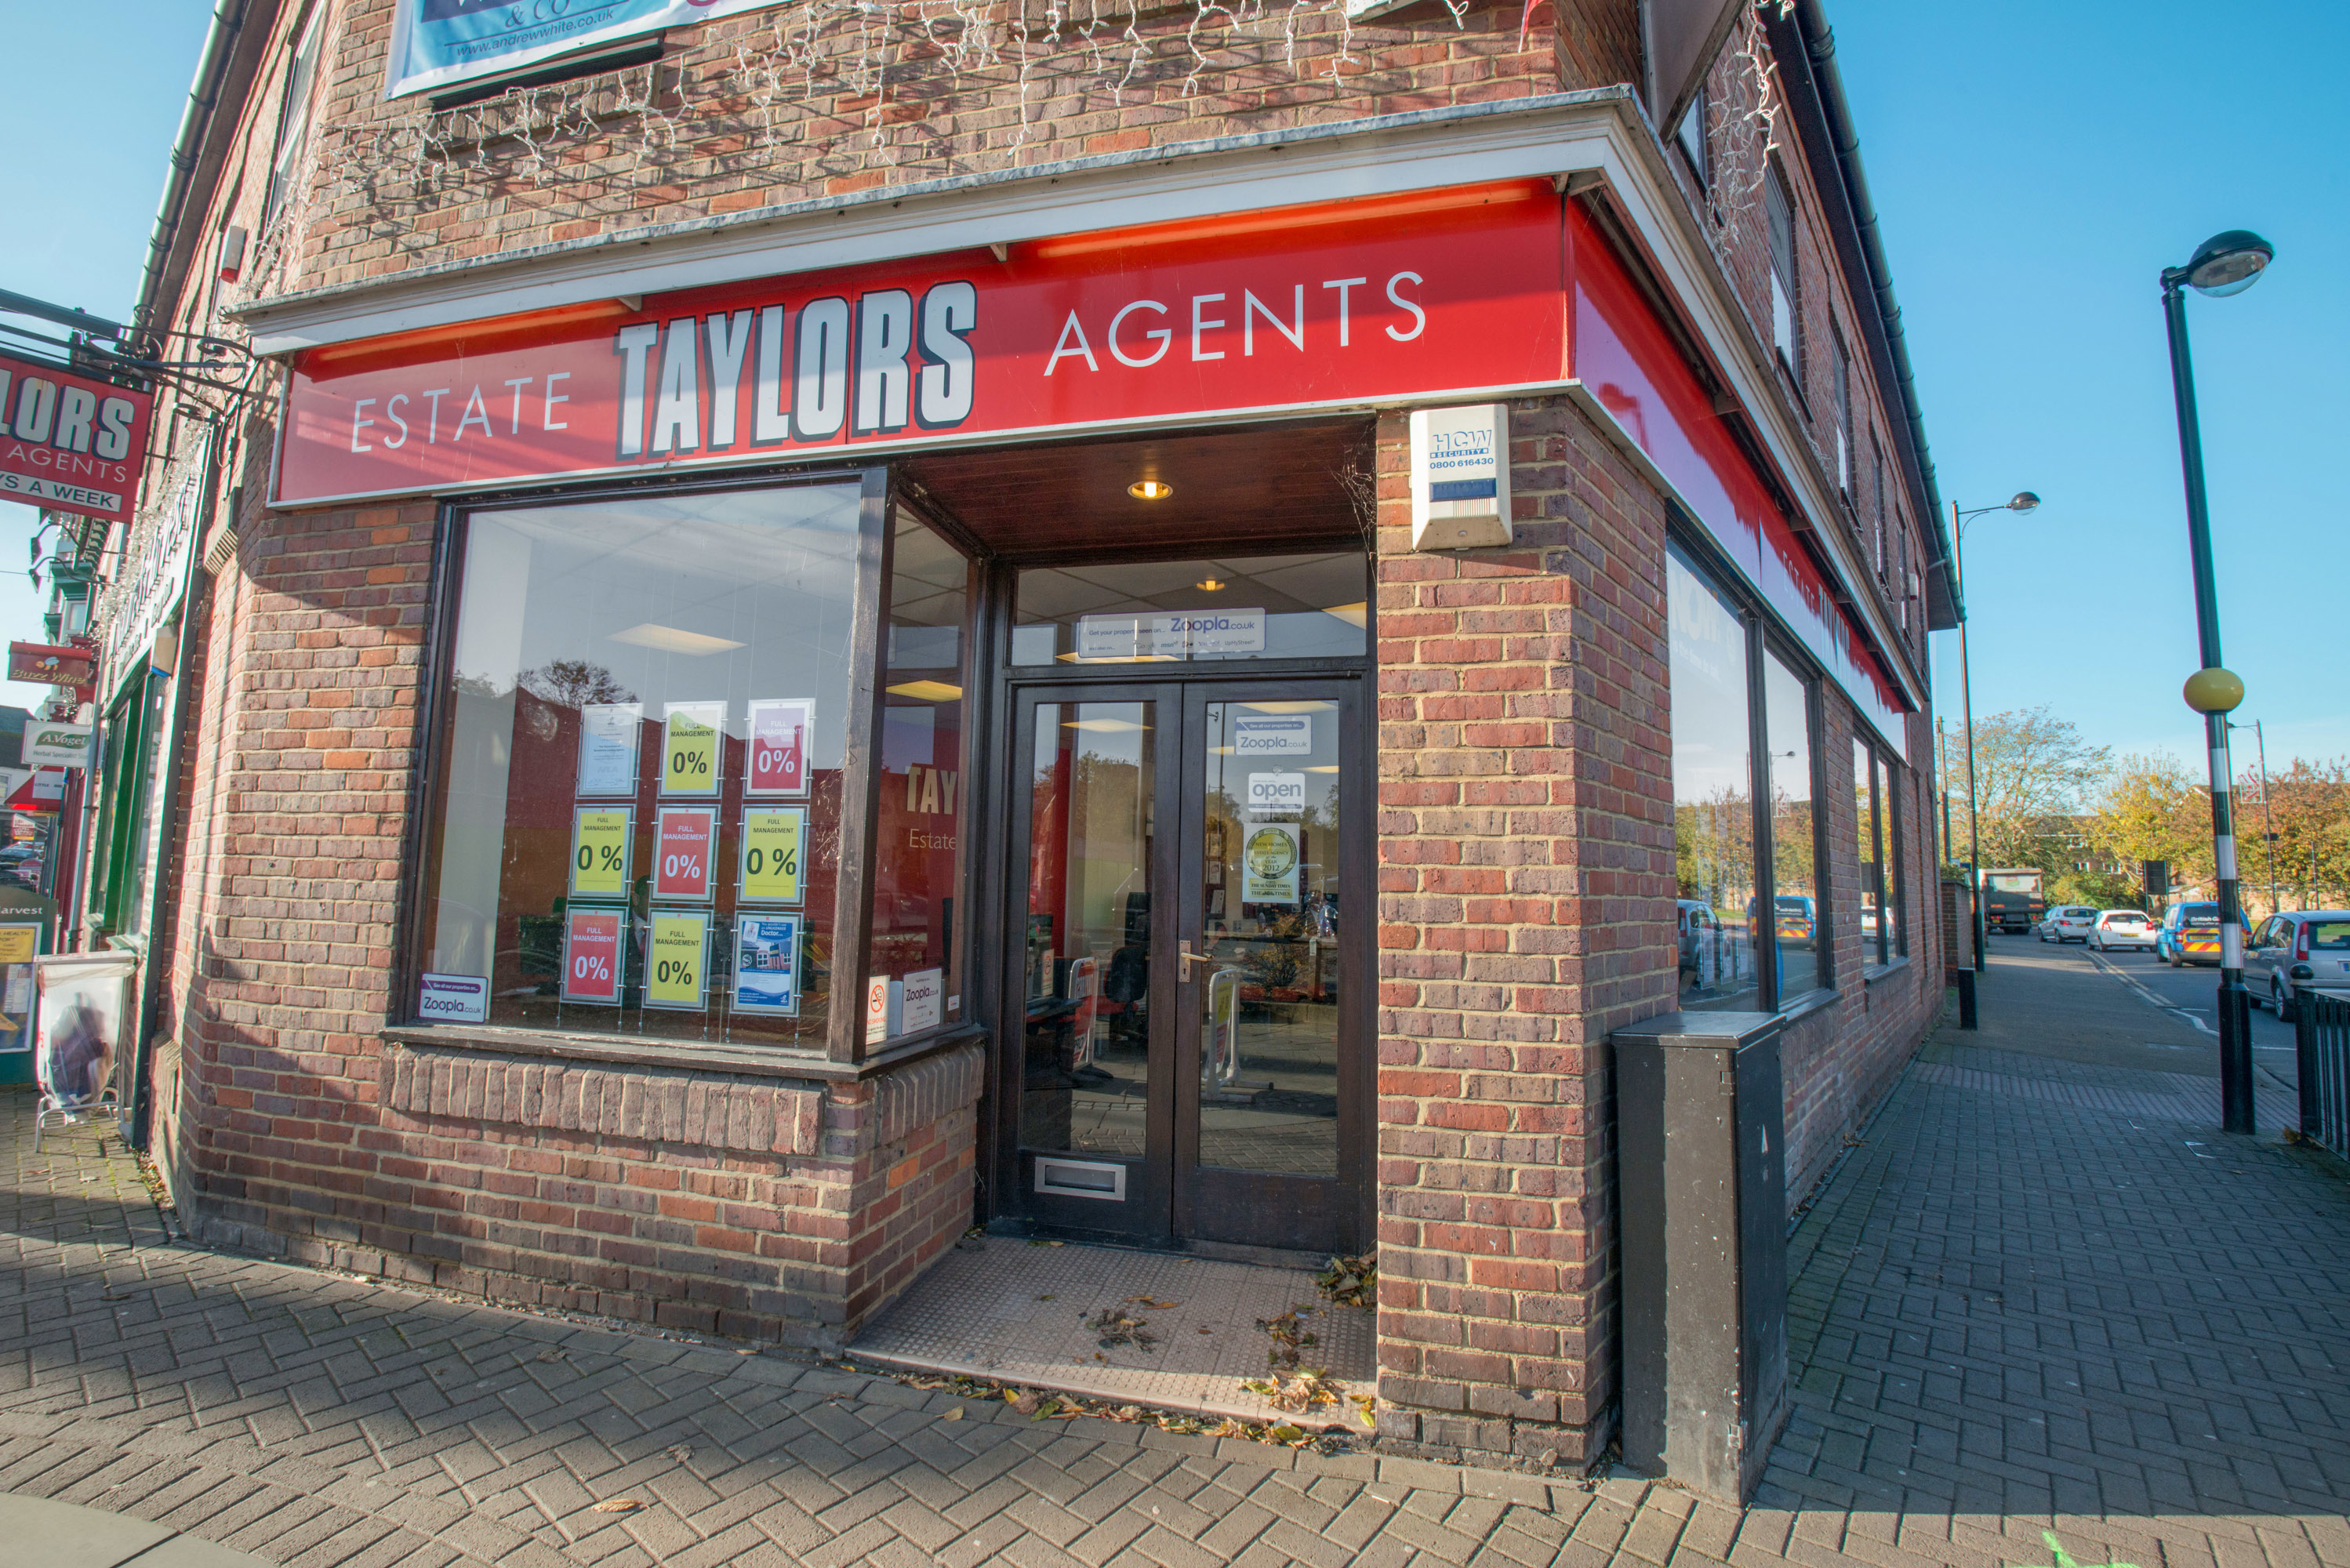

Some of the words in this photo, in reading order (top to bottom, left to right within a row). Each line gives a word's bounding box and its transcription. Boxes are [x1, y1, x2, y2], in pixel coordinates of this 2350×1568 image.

[504, 5, 525, 28] &
[457, 9, 614, 56] www.andrewwhite.co.uk
[351, 372, 572, 454] ESTATE
[616, 280, 977, 461] TAYLORS
[1044, 270, 1426, 376] AGENTS
[7, 444, 126, 483] AGENTS
[1429, 461, 1456, 470] 0800
[1457, 457, 1494, 467] 616430
[1437, 448, 1481, 458] SECURITY
[28, 481, 43, 495] A
[53, 484, 113, 509] WEEK
[1171, 615, 1255, 634] Zoopla.co.uk
[12, 670, 48, 681] Buzz
[42, 734, 86, 746] A.Vogel
[1240, 736, 1308, 750] Zoopla.co.uk
[673, 751, 707, 774] 0%
[758, 750, 795, 774] 0%
[905, 765, 958, 815] TAY
[1252, 783, 1302, 800] open
[910, 828, 957, 851] Estate
[665, 855, 700, 879] 0%
[0, 906, 43, 915] arvest
[575, 956, 608, 980] 0%
[658, 960, 692, 985] 0%
[424, 996, 482, 1014] Zoopla.co.uk
[906, 985, 939, 1002] Zoopla.co.uk
